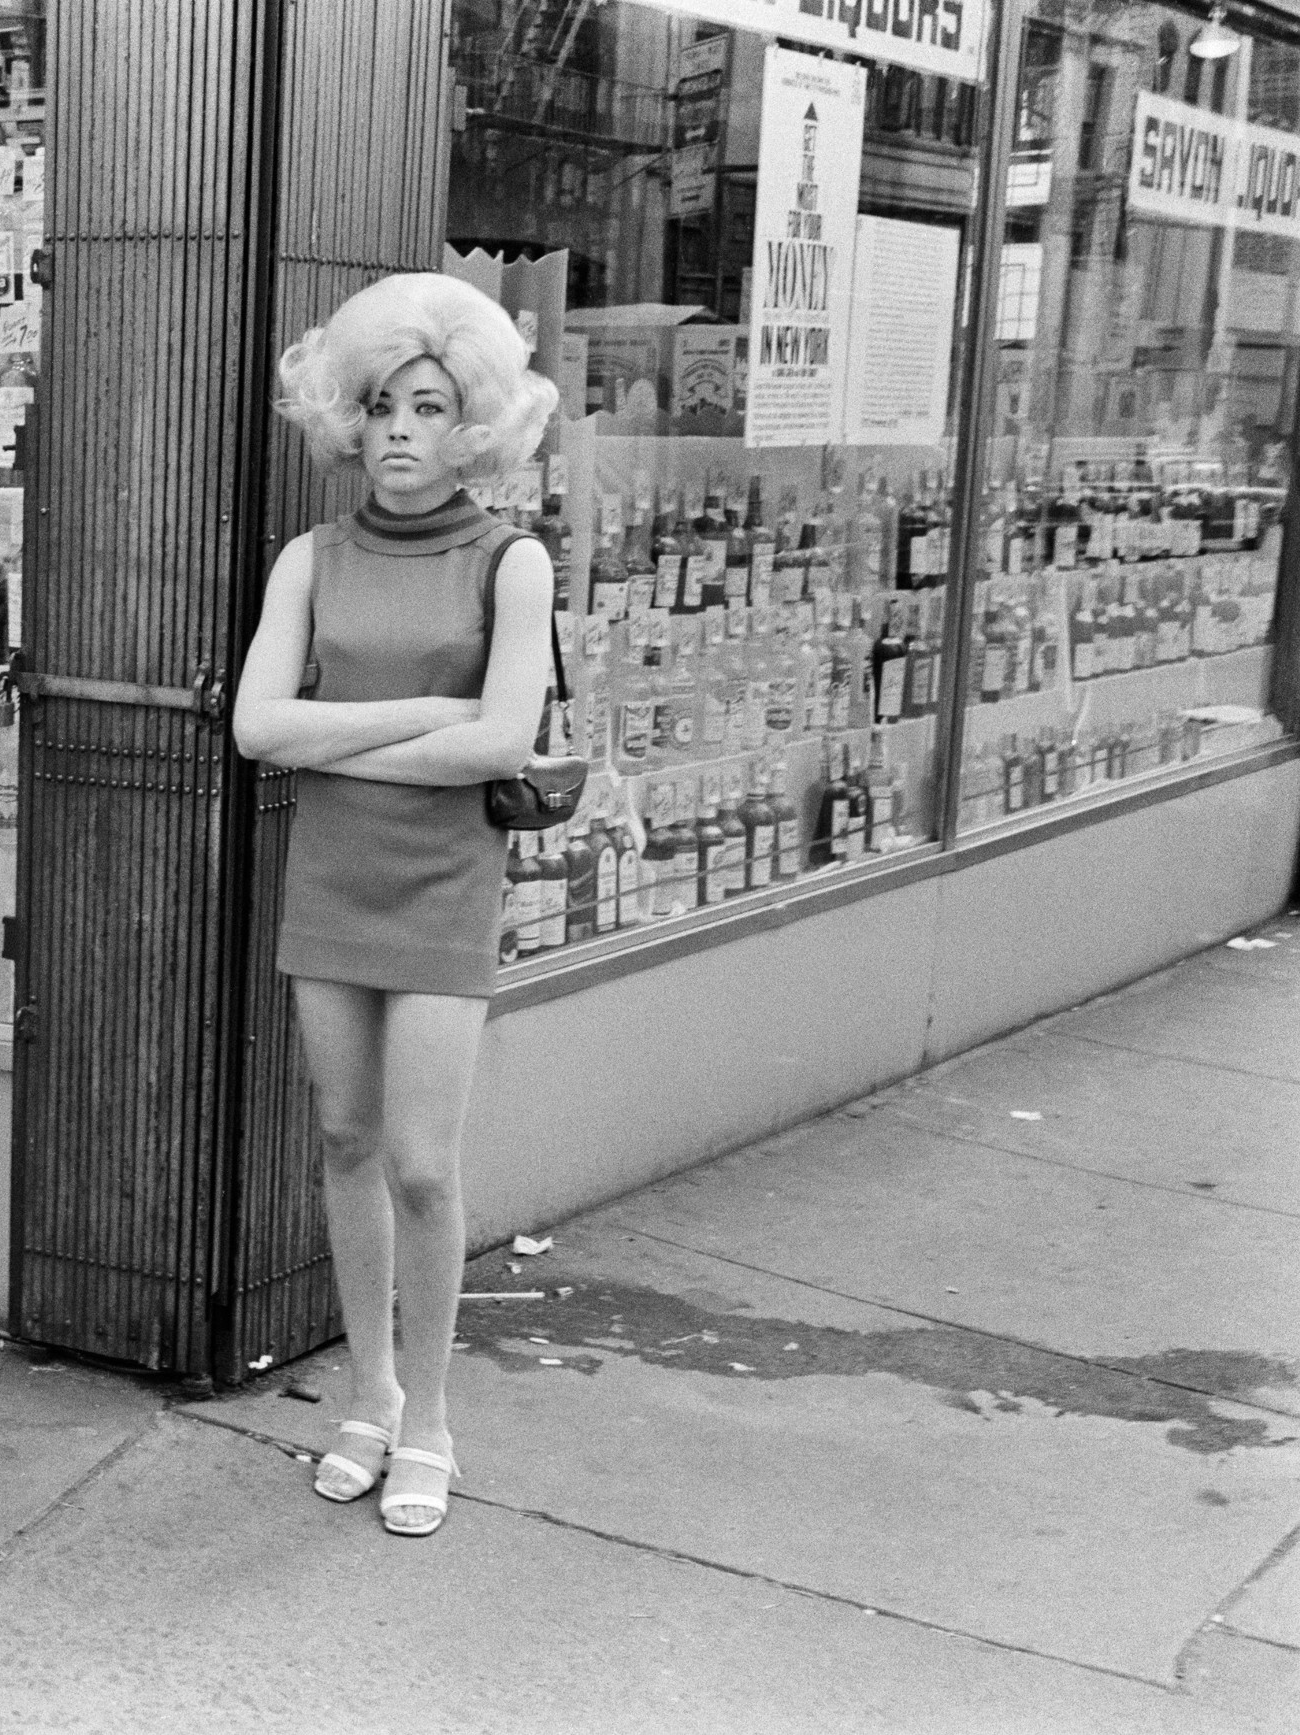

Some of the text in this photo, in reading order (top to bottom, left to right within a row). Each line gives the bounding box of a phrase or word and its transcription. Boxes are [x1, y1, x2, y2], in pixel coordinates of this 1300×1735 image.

[1236, 140, 1300, 220] LIQUO
[763, 240, 835, 311] MONEY
[760, 325, 831, 365] IN NEW YORK
